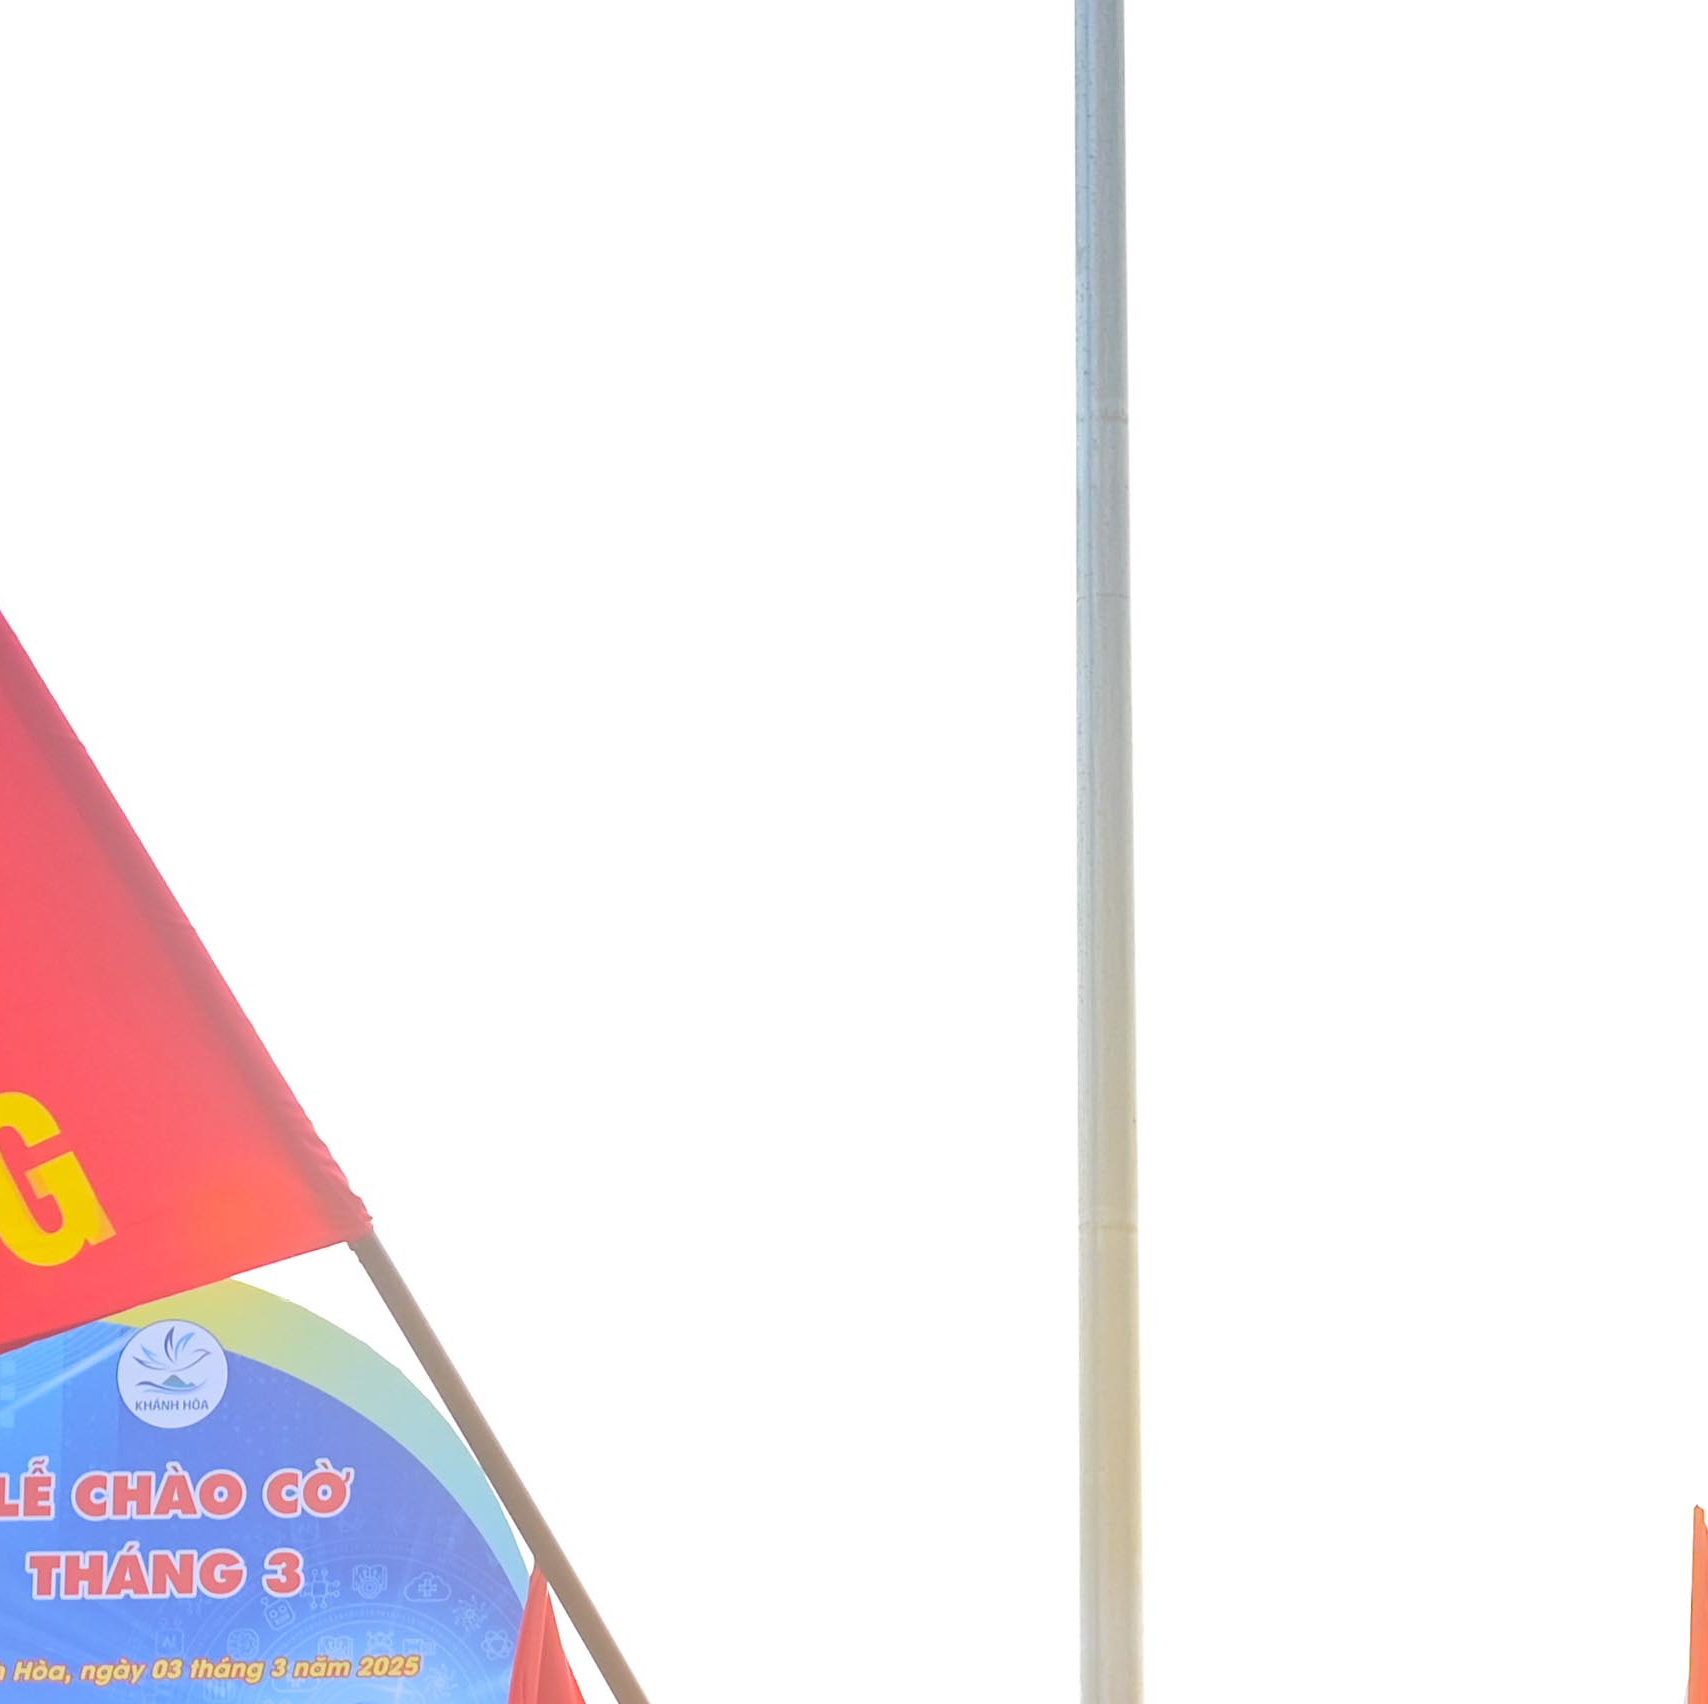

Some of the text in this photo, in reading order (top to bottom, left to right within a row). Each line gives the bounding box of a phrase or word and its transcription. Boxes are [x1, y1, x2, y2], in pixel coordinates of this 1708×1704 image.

[134, 1398, 210, 1412] KHÁNH HÒA
[74, 1462, 245, 1519] CHÀO
[266, 1461, 352, 1516] CỜ
[28, 1543, 303, 1598] THÁNG 3
[13, 1659, 72, 1685] Hòa,
[80, 1659, 145, 1686] ngày
[150, 1657, 184, 1681] 03
[189, 1654, 265, 1685] tháng
[270, 1656, 289, 1679] 3
[291, 1655, 352, 1679] năm
[356, 1653, 422, 1678] 2025
